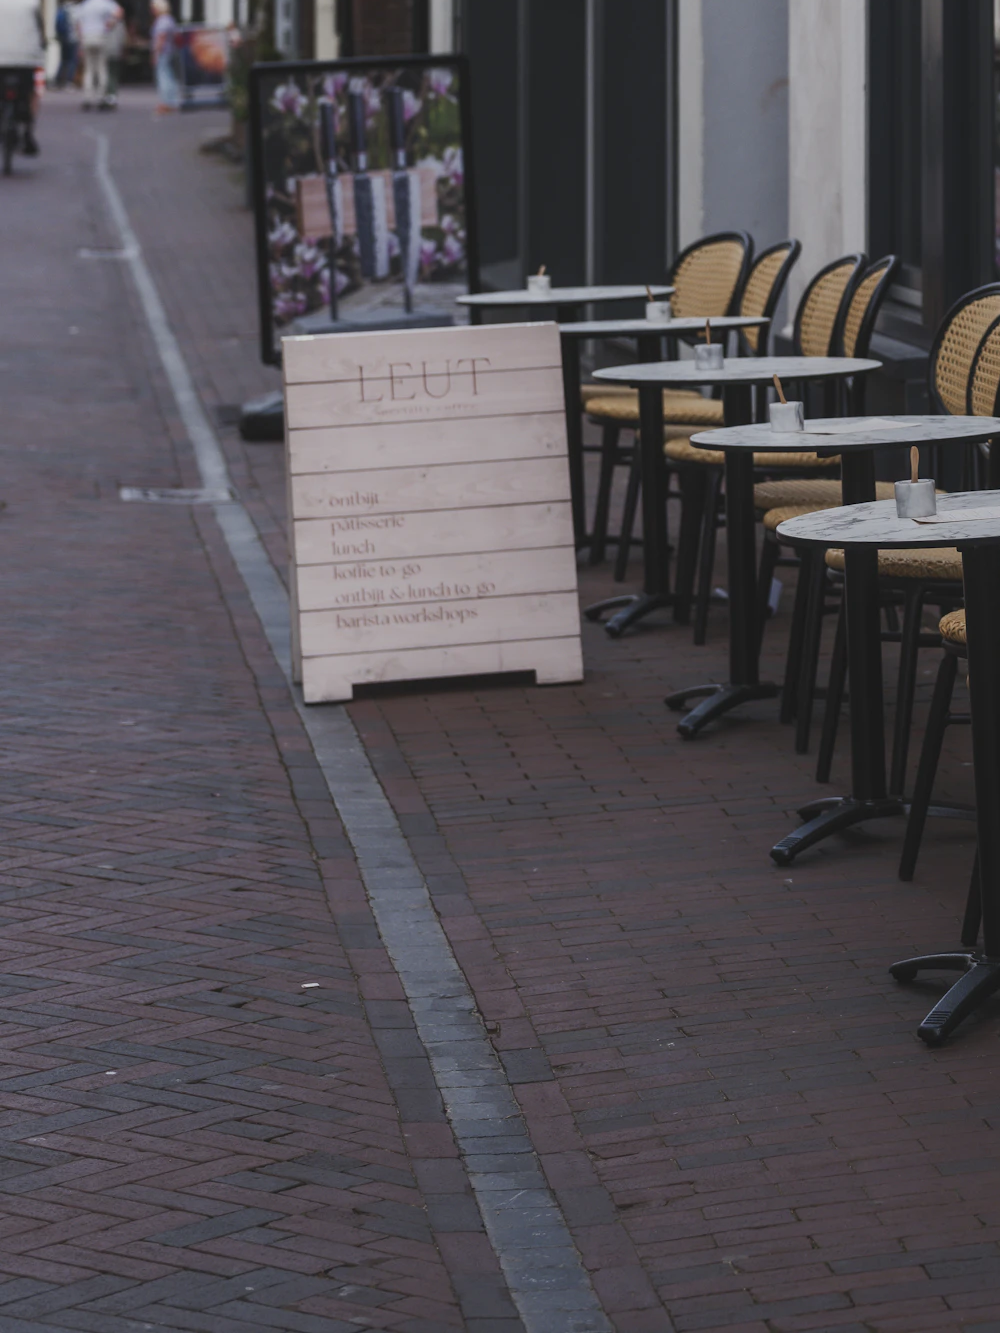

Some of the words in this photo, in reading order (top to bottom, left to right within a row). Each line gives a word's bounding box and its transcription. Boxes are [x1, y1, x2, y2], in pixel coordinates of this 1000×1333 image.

[357, 357, 491, 404] LEUT
[328, 492, 380, 509] ontbijt
[332, 539, 376, 556] lunch
[333, 564, 376, 580] koffie
[379, 565, 396, 578] to
[402, 563, 421, 580] go
[334, 587, 386, 605] ontbijt
[408, 582, 452, 598] lunch
[454, 581, 471, 596] to
[476, 581, 496, 600] go
[336, 614, 391, 630] barista
[392, 606, 479, 624] workshops
